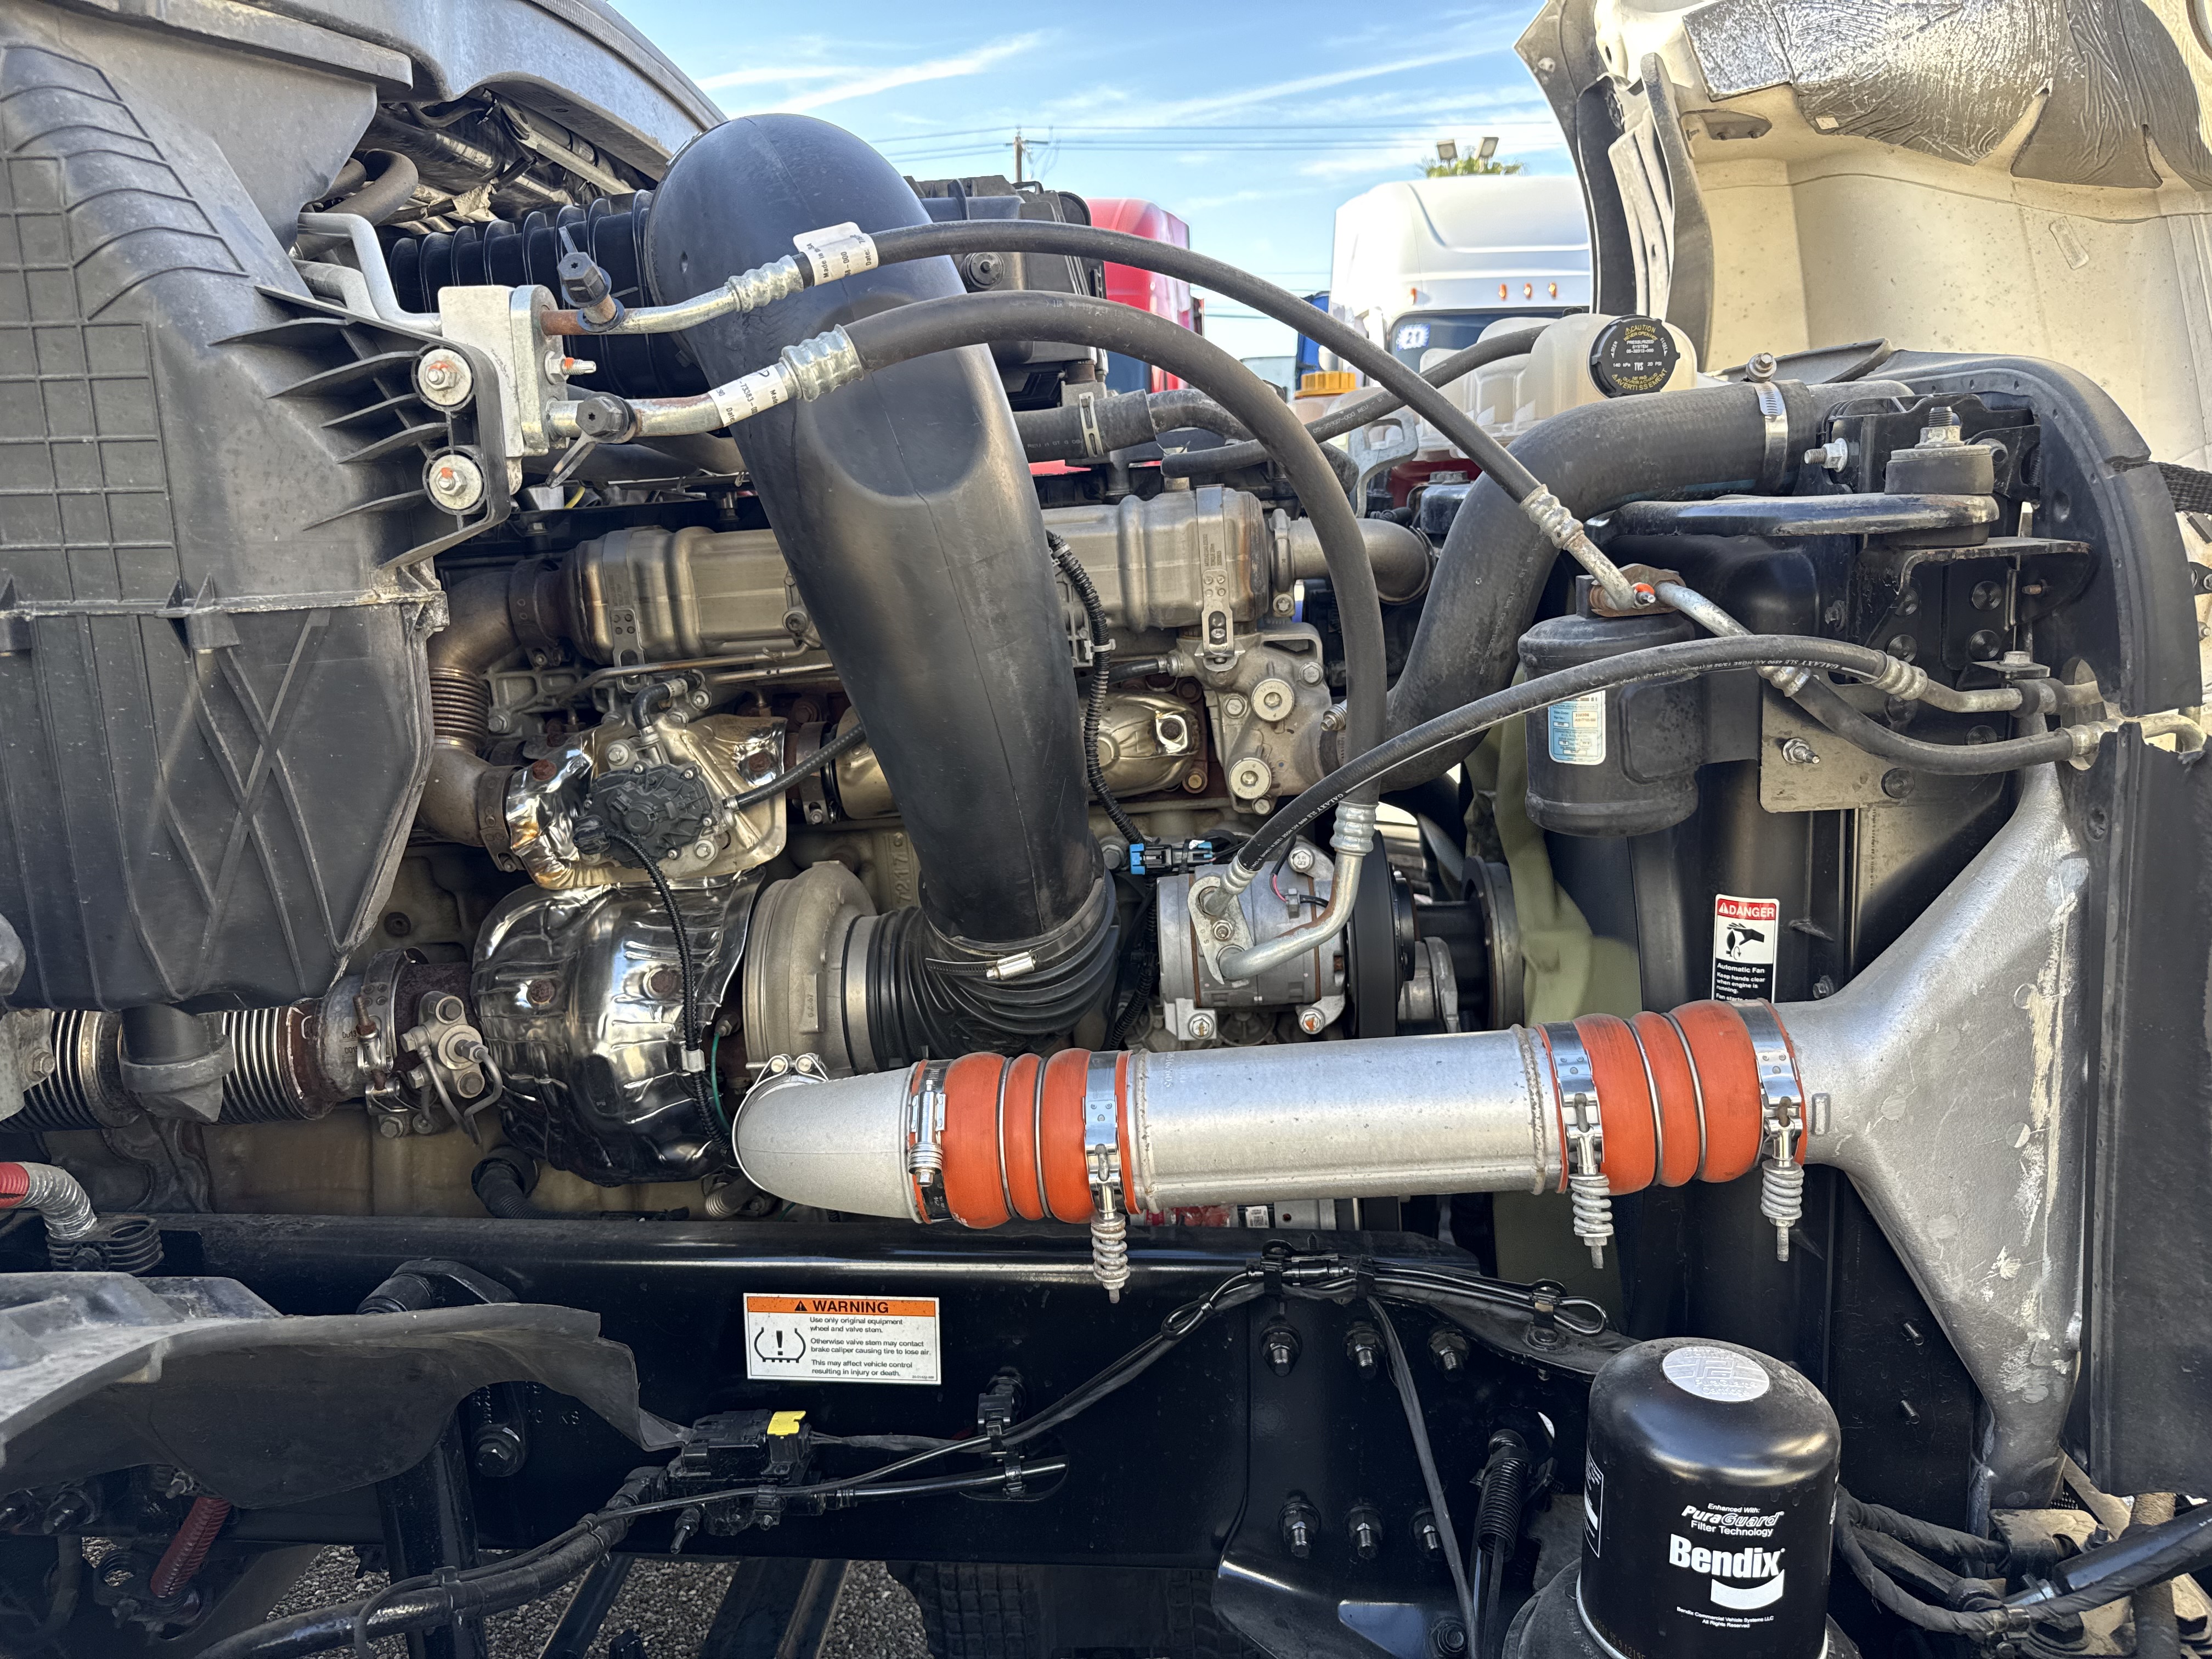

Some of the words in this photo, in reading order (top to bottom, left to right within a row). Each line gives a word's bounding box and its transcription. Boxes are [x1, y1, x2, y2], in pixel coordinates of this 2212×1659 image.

[821, 259, 830, 278] Made
[1630, 324, 1656, 333] CAUTION
[1406, 331, 1420, 345] 21
[1623, 332, 1638, 341] NEVER
[1634, 362, 1644, 371] TVS
[1801, 660, 1840, 669] GALAXY
[1316, 793, 1344, 812] GALAXY
[1281, 829, 1293, 838] HOSE
[1729, 907, 1775, 918] DANGER
[1717, 963, 1751, 973] Automatic
[1716, 985, 1739, 994] running.
[812, 1300, 889, 1313] WARNING
[840, 1317, 866, 1325] original
[1707, 1503, 1742, 1513] Enhanced
[1691, 1520, 1717, 1532] Filter
[1718, 1525, 1774, 1537] Technology
[1669, 1533, 1781, 1578] Bendix
[1677, 1606, 1694, 1616] Bendix
[1694, 1612, 1725, 1621] Commercial
